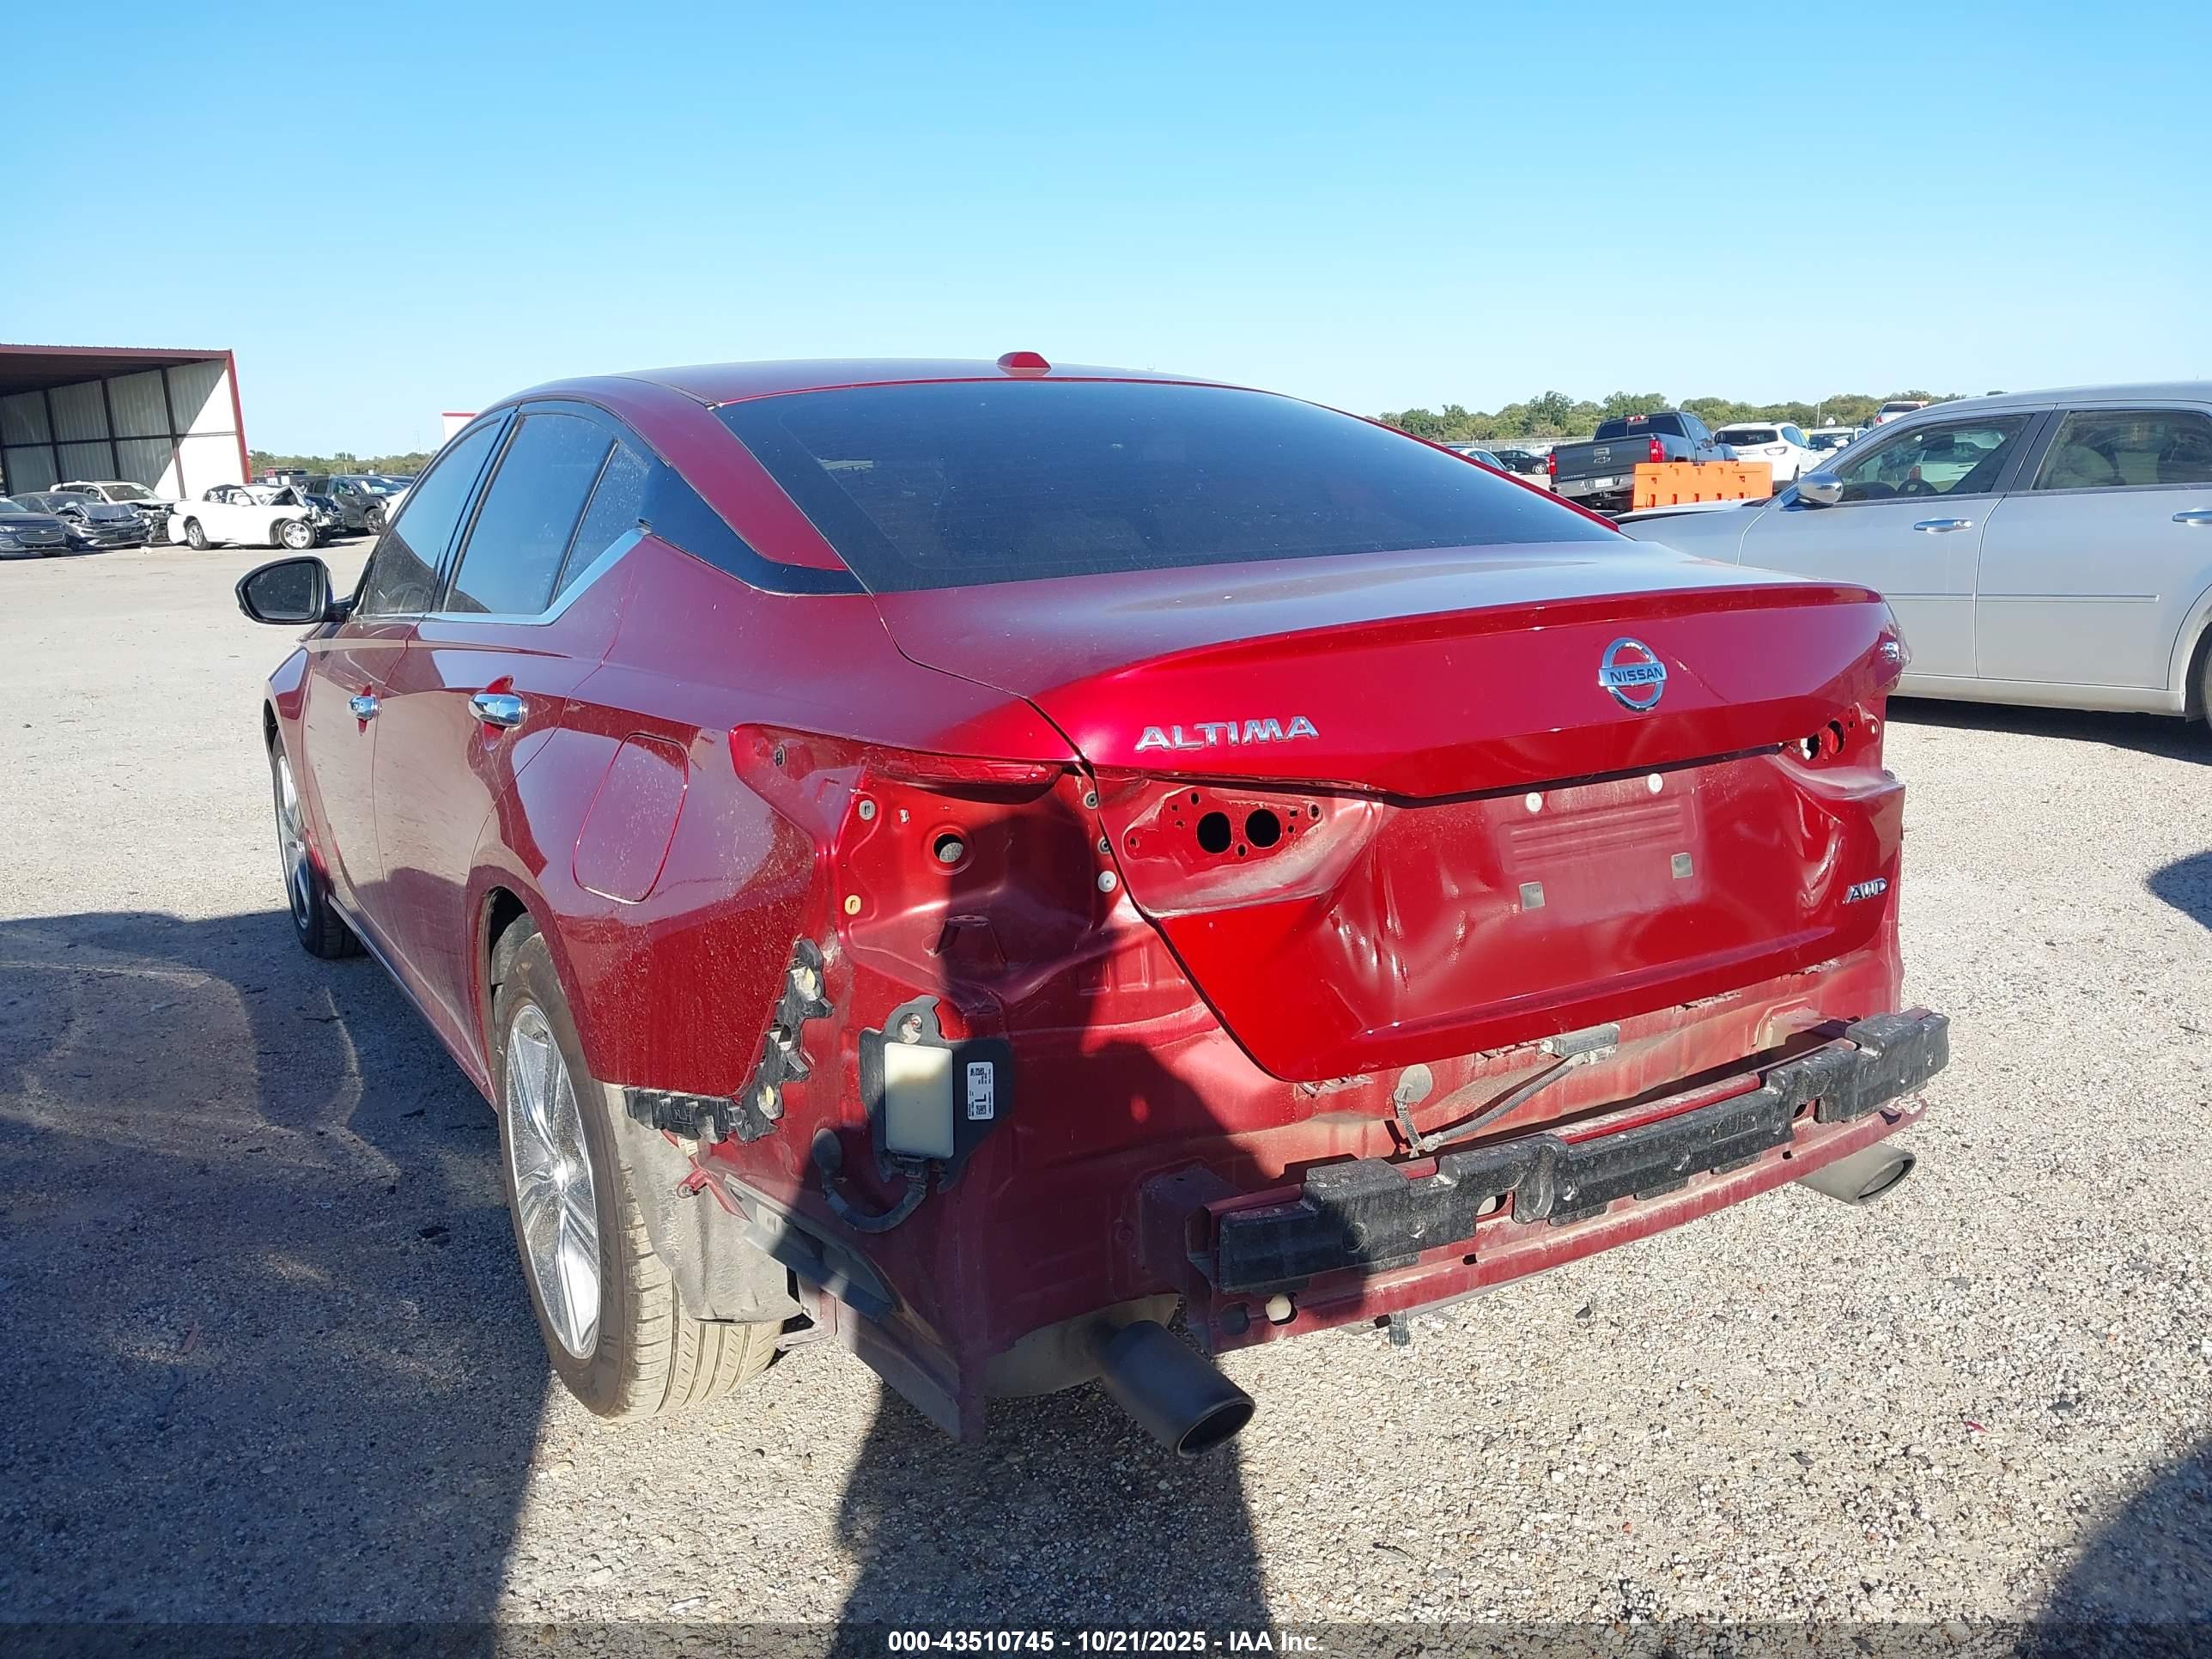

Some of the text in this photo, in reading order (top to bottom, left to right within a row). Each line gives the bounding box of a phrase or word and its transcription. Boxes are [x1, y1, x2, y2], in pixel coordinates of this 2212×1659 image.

[1609, 666, 1664, 683] NISSAN
[1134, 715, 1320, 751] ALTIMA
[1844, 878, 1888, 903] AWD
[974, 1093, 987, 1103] L
